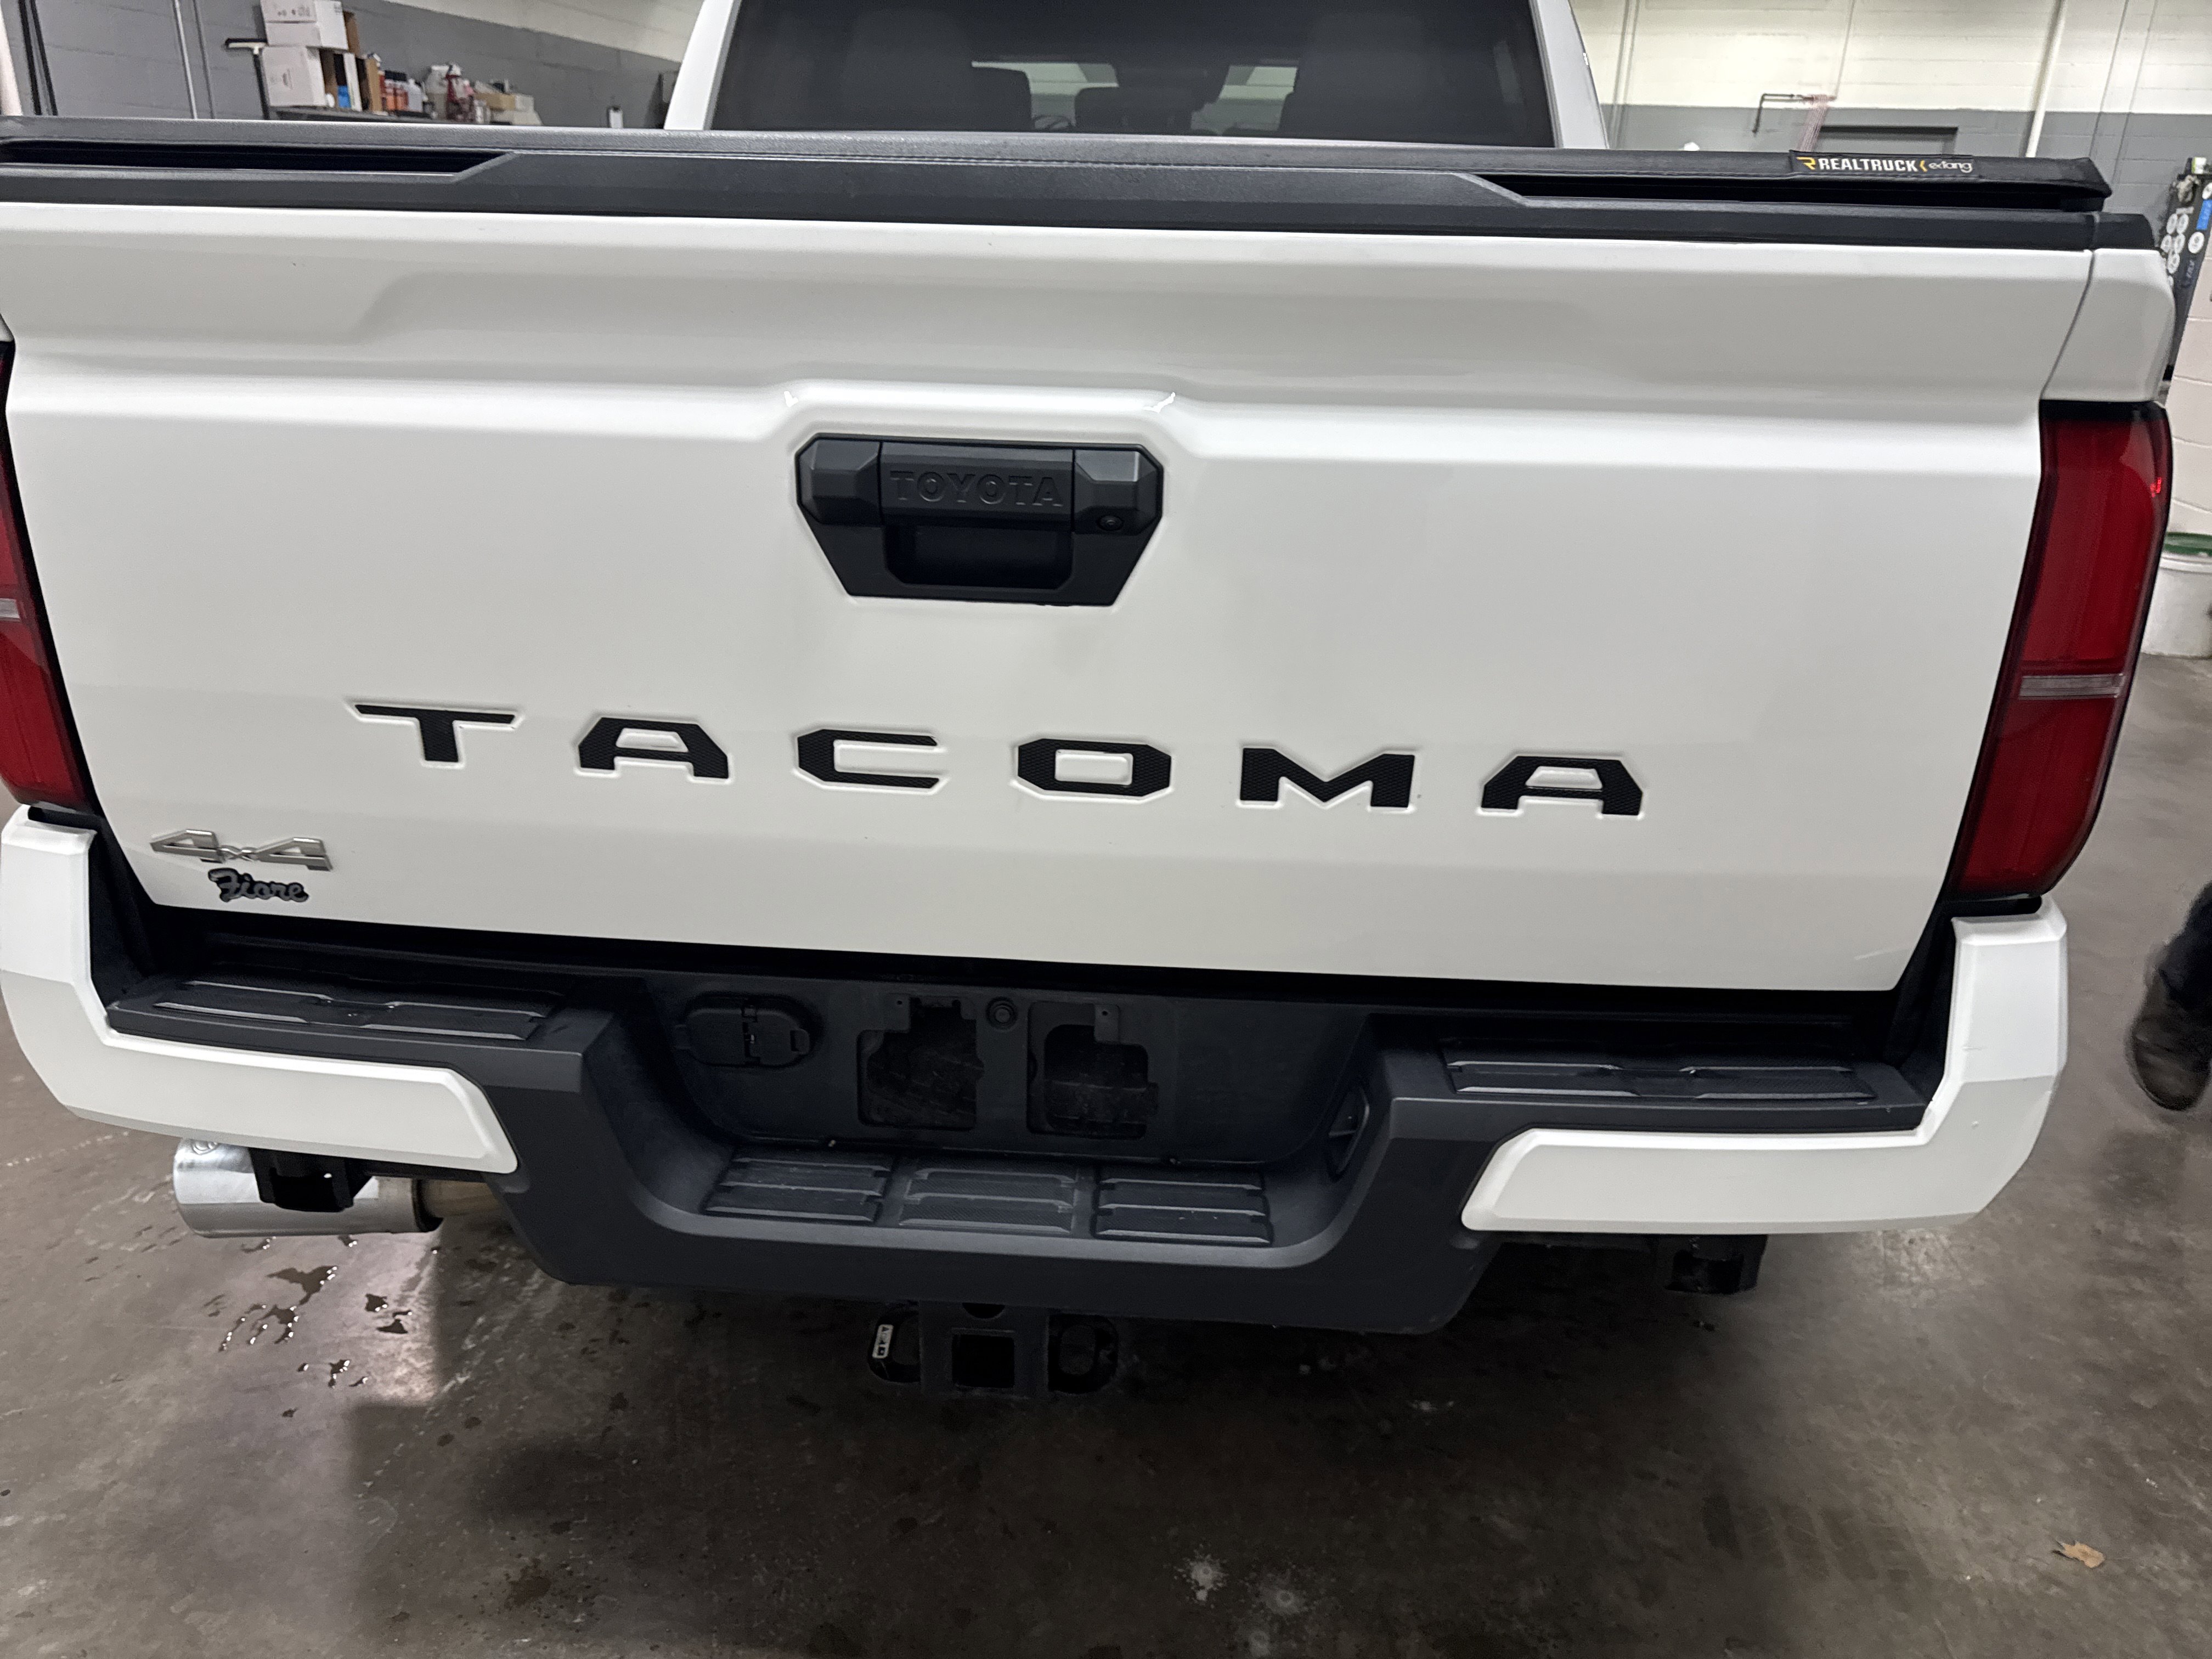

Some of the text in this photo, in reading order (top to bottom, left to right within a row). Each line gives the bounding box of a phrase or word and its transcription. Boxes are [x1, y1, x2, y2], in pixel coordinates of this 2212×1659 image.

[1818, 157, 1919, 172] REALTRUCK
[890, 470, 1063, 507] TOYOTA
[353, 703, 1643, 816] TACOMA
[208, 867, 309, 902] Fiore
